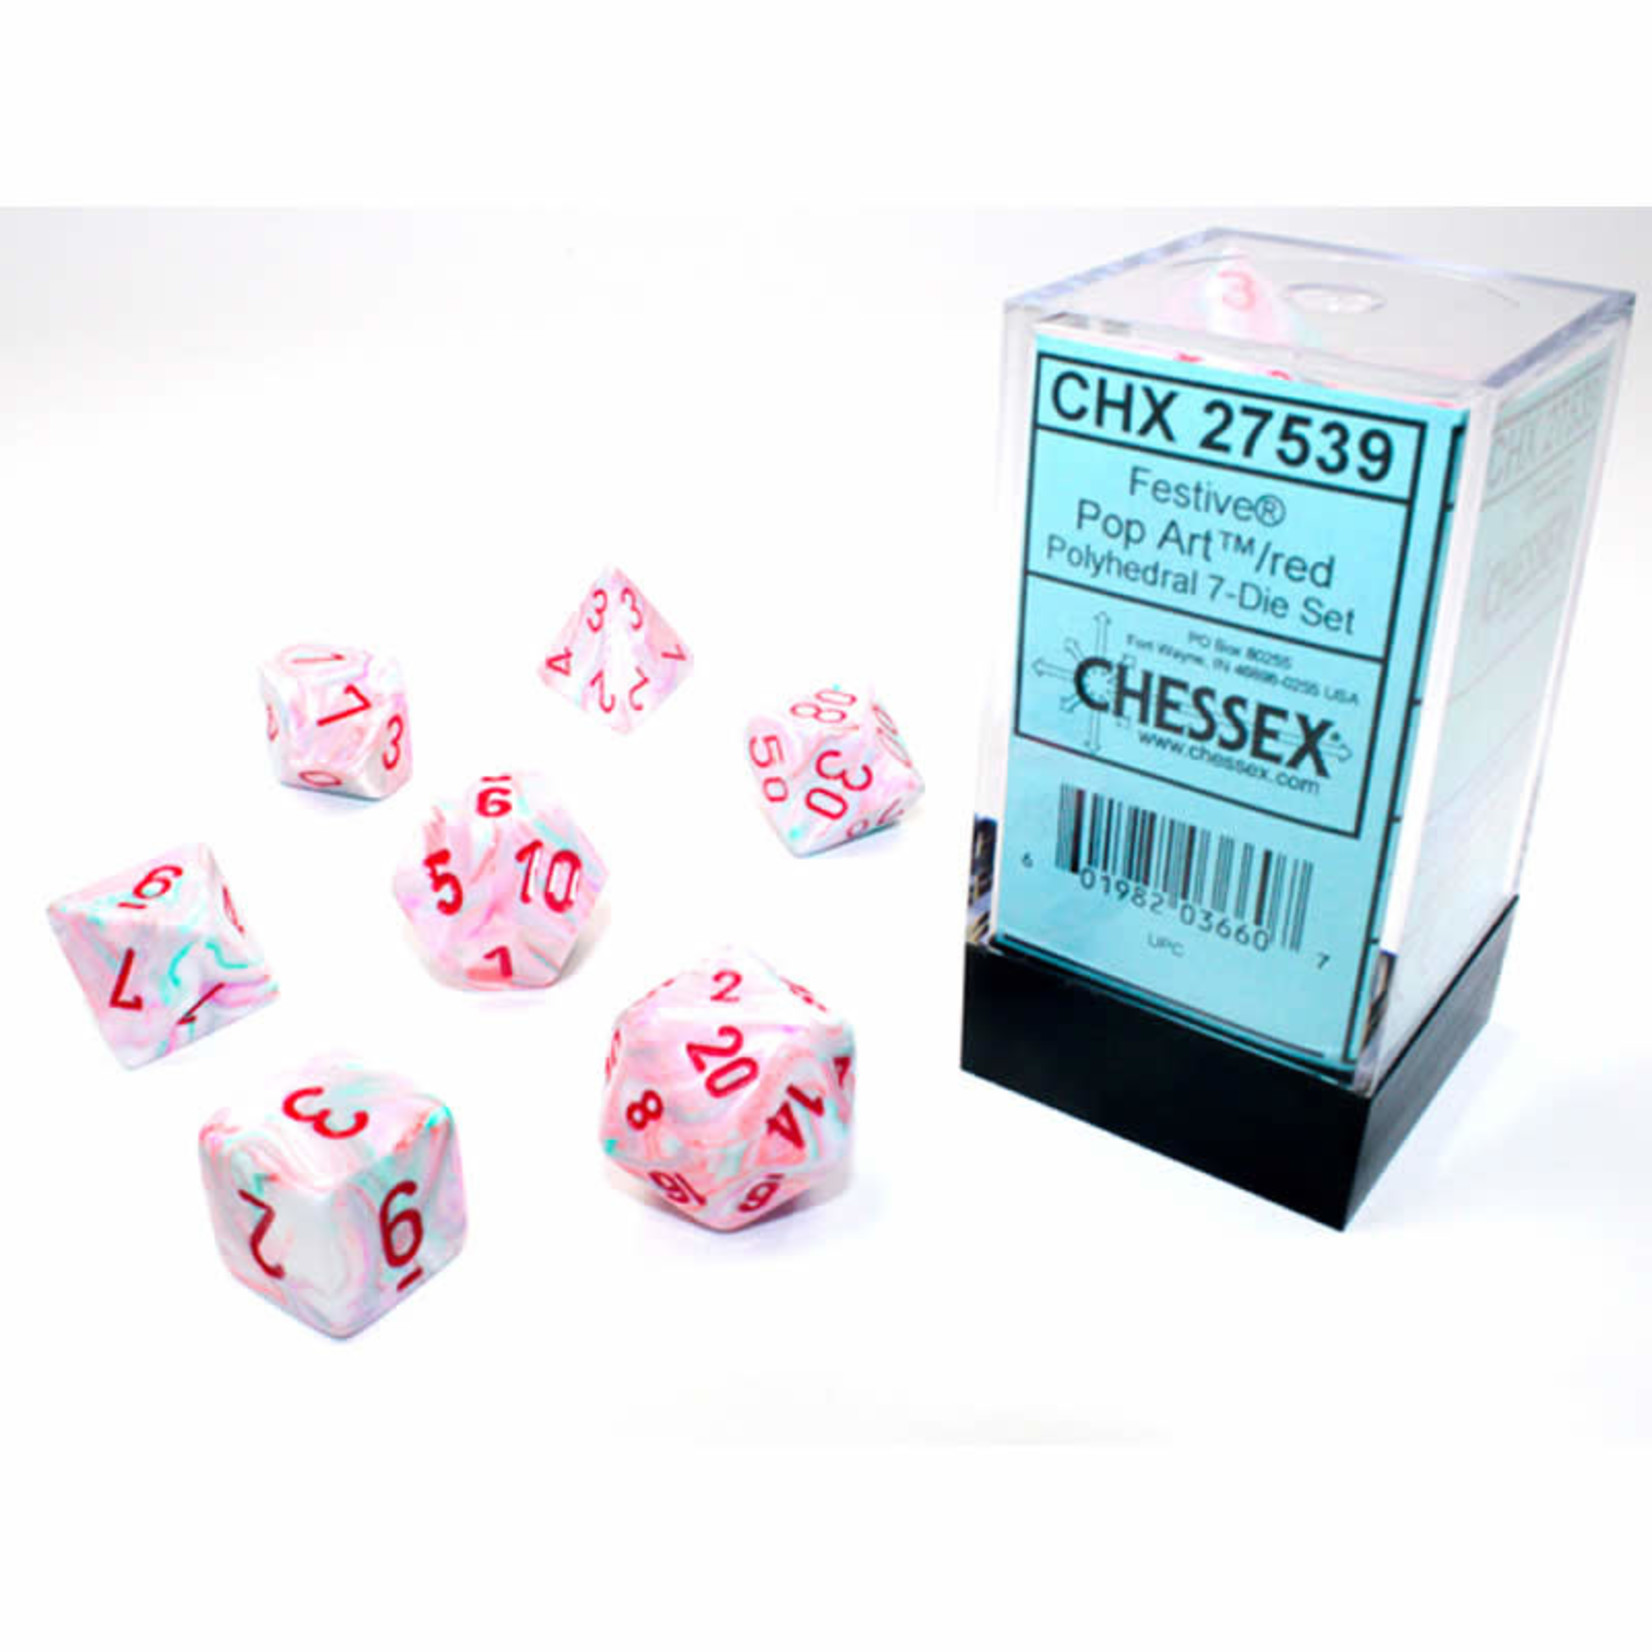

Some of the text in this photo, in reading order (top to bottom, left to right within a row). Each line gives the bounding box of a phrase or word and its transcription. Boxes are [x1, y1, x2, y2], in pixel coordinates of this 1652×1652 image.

[1052, 371, 1394, 483] CHX 27539
[1076, 499, 1146, 549] Pop
[1130, 466, 1286, 527] Festive®
[587, 589, 608, 633] 3
[620, 587, 643, 631] 3
[1047, 534, 1356, 635] Polyhedral 7-Die Set
[545, 647, 572, 676] 4
[1126, 634, 1154, 651] Fort
[1325, 686, 1360, 706] USA
[1188, 631, 1212, 648] PO
[1215, 638, 1242, 657] Box
[590, 669, 615, 713] 2
[628, 666, 649, 711] 2
[383, 714, 404, 770] 3
[749, 734, 788, 803] 50
[1138, 732, 1321, 795] www.chessex.com
[298, 770, 342, 787] 0
[805, 749, 873, 821] 30
[423, 849, 463, 915] 5
[516, 839, 583, 914] 10
[1021, 853, 1331, 971] 6 01982 03660 7
[1148, 933, 1184, 958] UPC
[710, 969, 743, 1003] 2
[686, 1025, 759, 1099] 20
[283, 1086, 369, 1140] 3
[626, 1089, 663, 1131] 8
[766, 1084, 825, 1149] 14
[237, 1188, 285, 1281] 2
